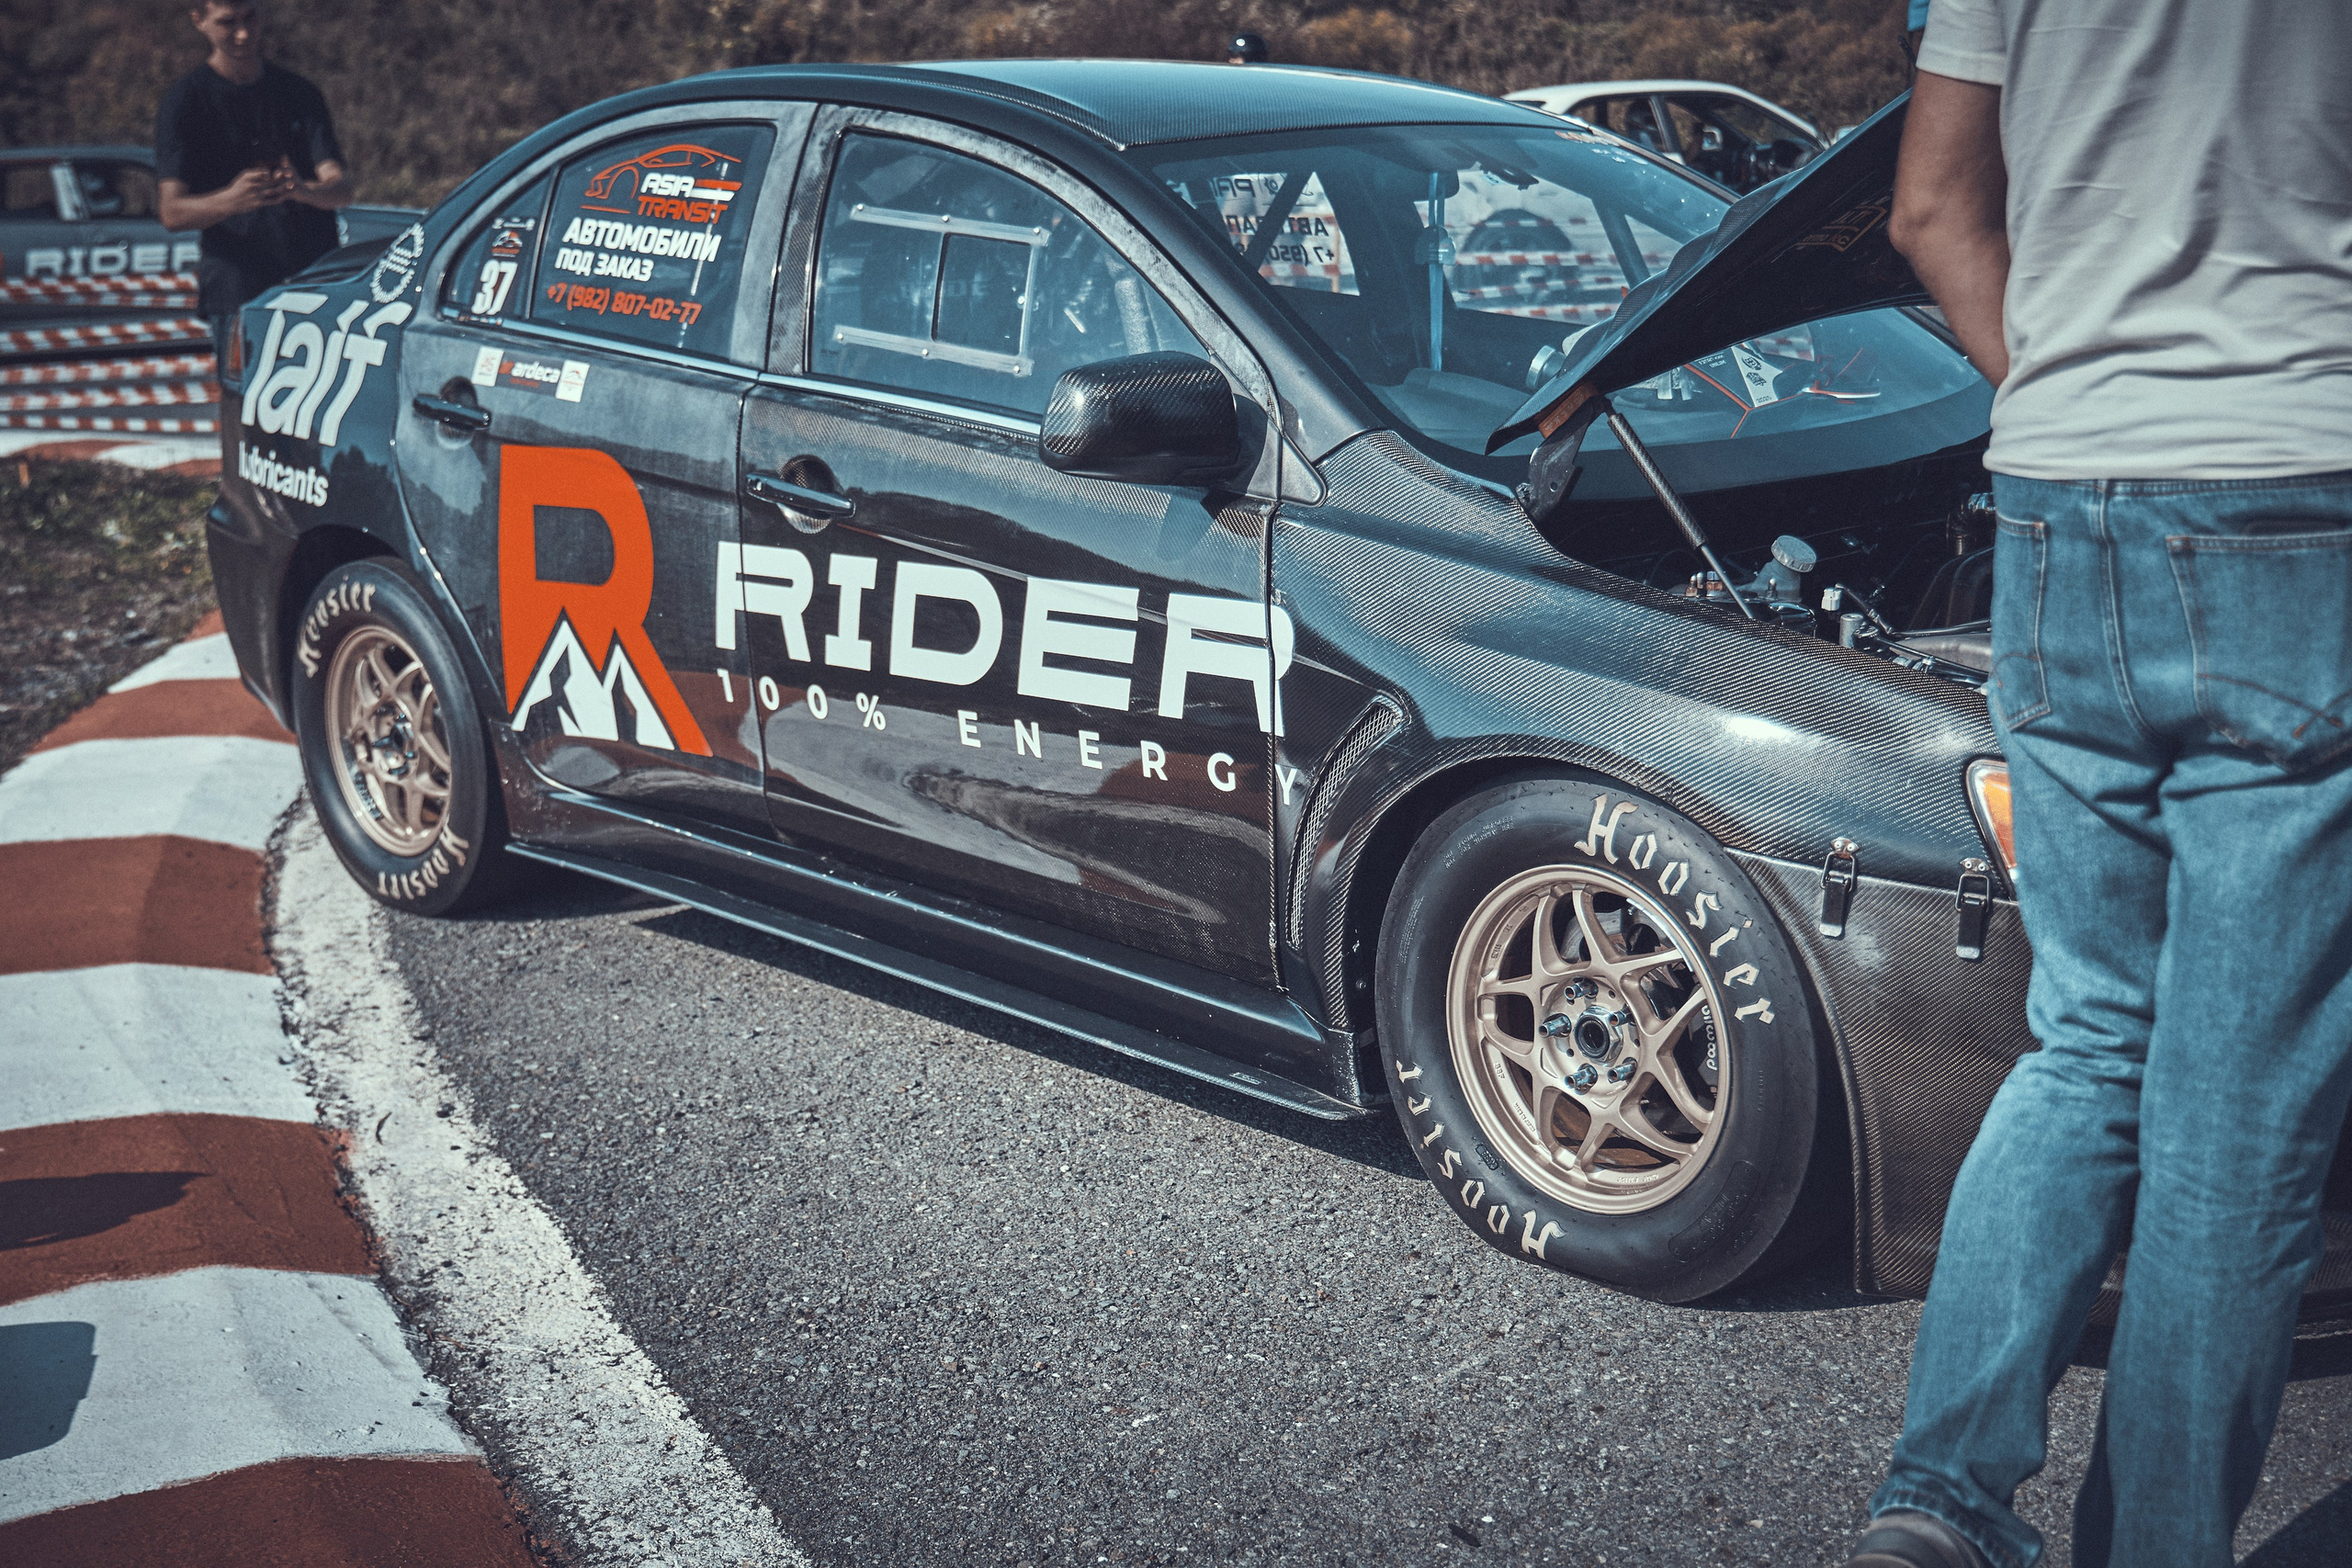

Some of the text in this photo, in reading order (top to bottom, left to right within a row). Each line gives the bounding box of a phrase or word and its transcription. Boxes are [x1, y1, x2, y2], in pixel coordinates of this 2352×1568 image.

[640, 172, 695, 197] ASIA
[638, 196, 728, 225] TRANSIT
[554, 247, 594, 276] ПОД
[593, 253, 654, 282] ЗАКАЗ
[562, 217, 721, 263] АВТОМОБИЛИ
[471, 259, 518, 316] 37
[547, 282, 703, 326] +7 (982) 807-02-77
[511, 360, 561, 384] ardeca
[239, 441, 329, 508] lubricants
[715, 540, 1294, 738] RIDER
[957, 709, 1298, 806] ENERGY
[1574, 793, 1775, 1025] Hoosier
[1396, 1059, 1567, 1260] Hoosier
